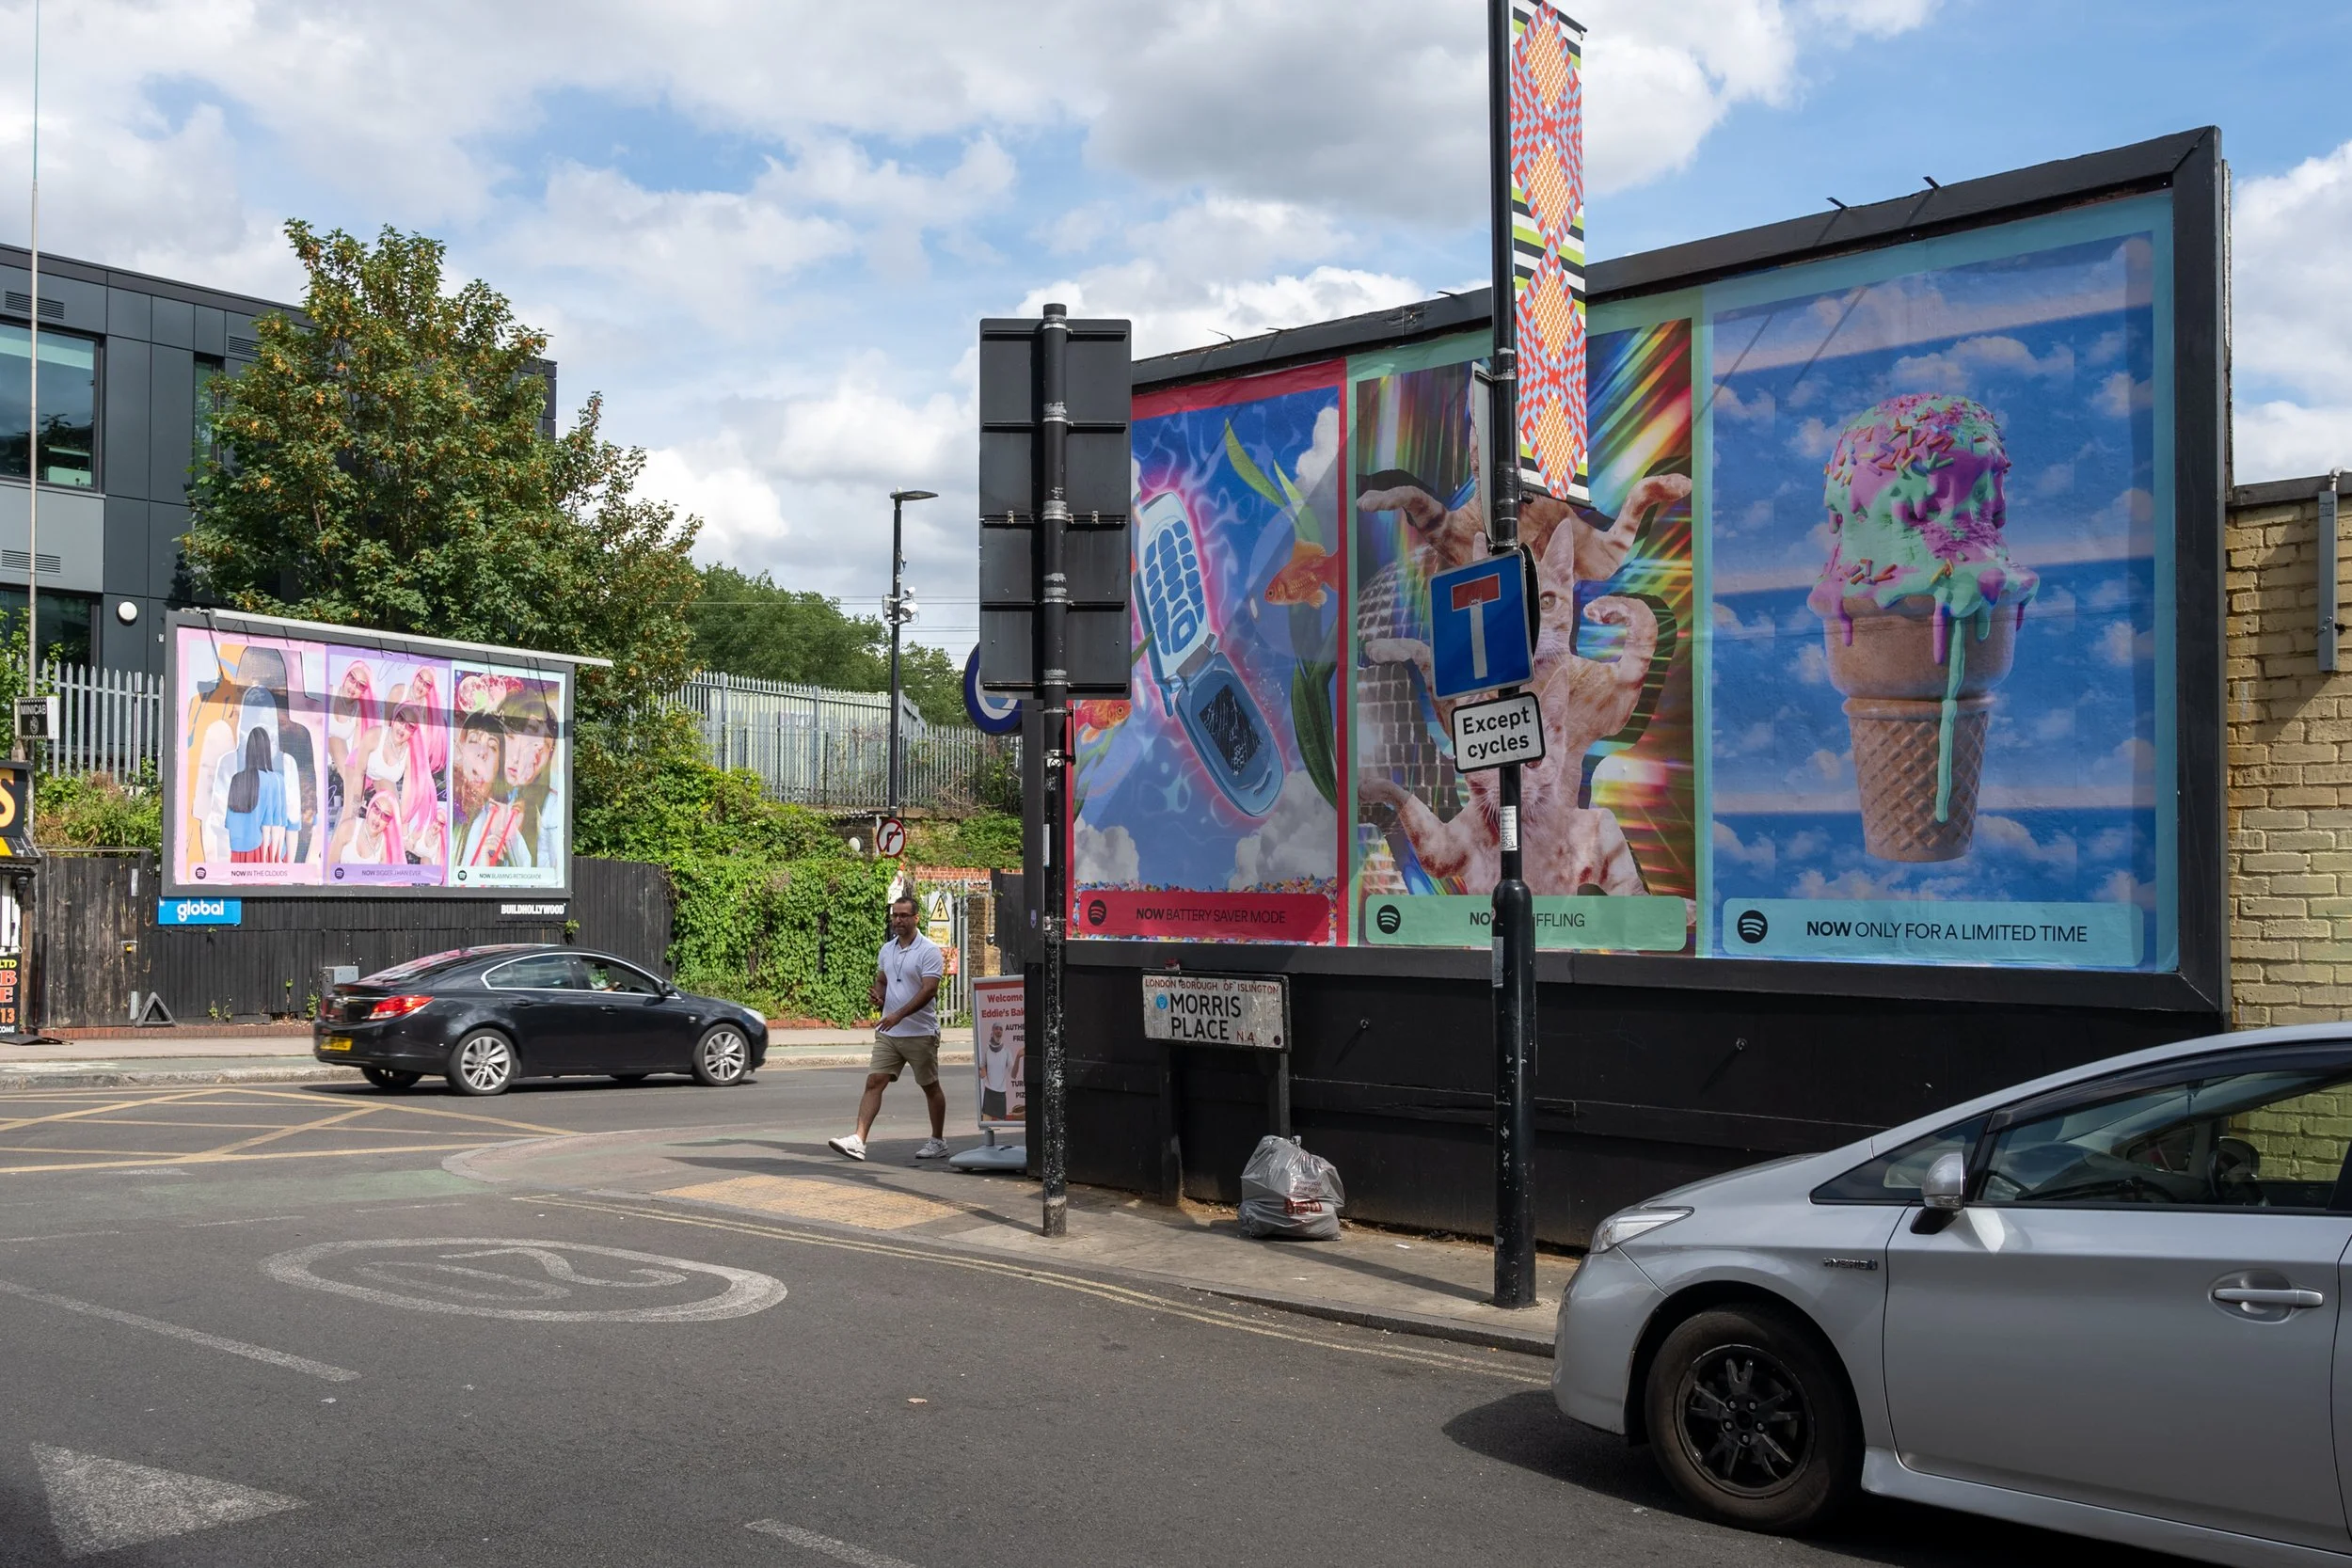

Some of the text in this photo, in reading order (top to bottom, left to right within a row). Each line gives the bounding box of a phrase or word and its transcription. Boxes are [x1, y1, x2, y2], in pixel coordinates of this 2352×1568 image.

[21, 705, 46, 715] MINICAB
[1462, 706, 1531, 735] Except
[1468, 735, 1530, 759] cycles
[177, 898, 224, 922] global
[501, 904, 564, 915] BUILDHOLLYWOOD
[1136, 908, 1286, 924] NOW BATTERY SAVER MODE
[1470, 912, 1491, 926] NO
[1806, 921, 2088, 942] NOW ONLY FOR A LIMITED TIME
[1145, 979, 1279, 994] LONDON BOROUGH OF ISLINGTON
[987, 992, 1023, 1003] Welcome
[1169, 992, 1242, 1018] MORRIS
[981, 1008, 1009, 1018] Eddie's
[1170, 1017, 1230, 1040] PLACE
